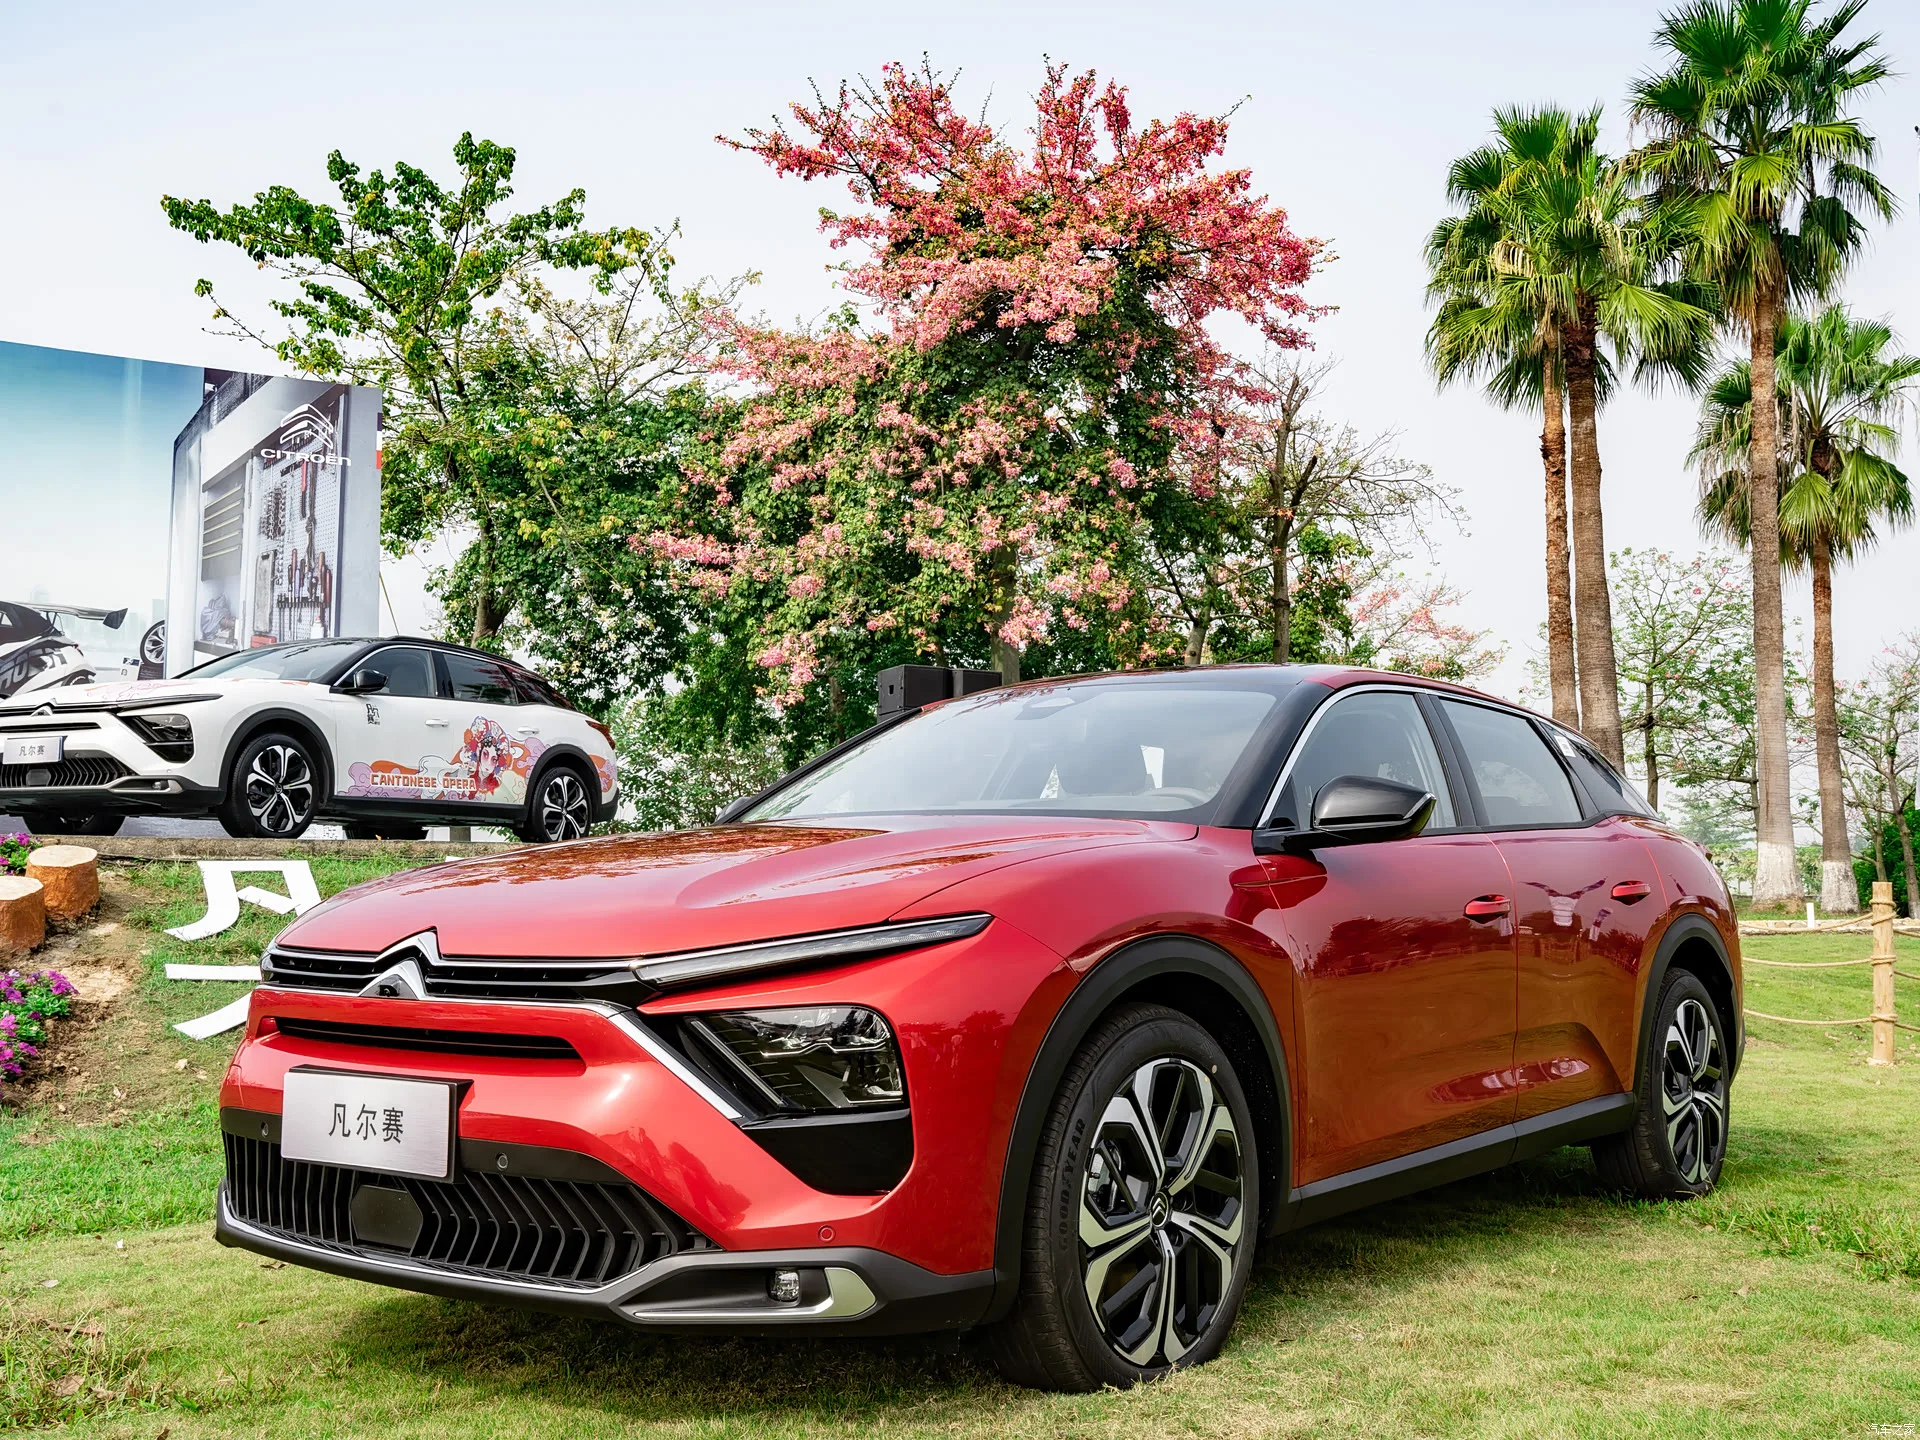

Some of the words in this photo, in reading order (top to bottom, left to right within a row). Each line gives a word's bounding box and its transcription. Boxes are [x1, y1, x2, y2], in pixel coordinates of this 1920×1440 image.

[19, 745, 45, 756] 凡尔赛
[370, 773, 437, 788] CANTONESE
[442, 777, 476, 790] OPERA
[329, 1103, 404, 1144] 凡尔赛
[1058, 1117, 1087, 1251] GOODYEAR
